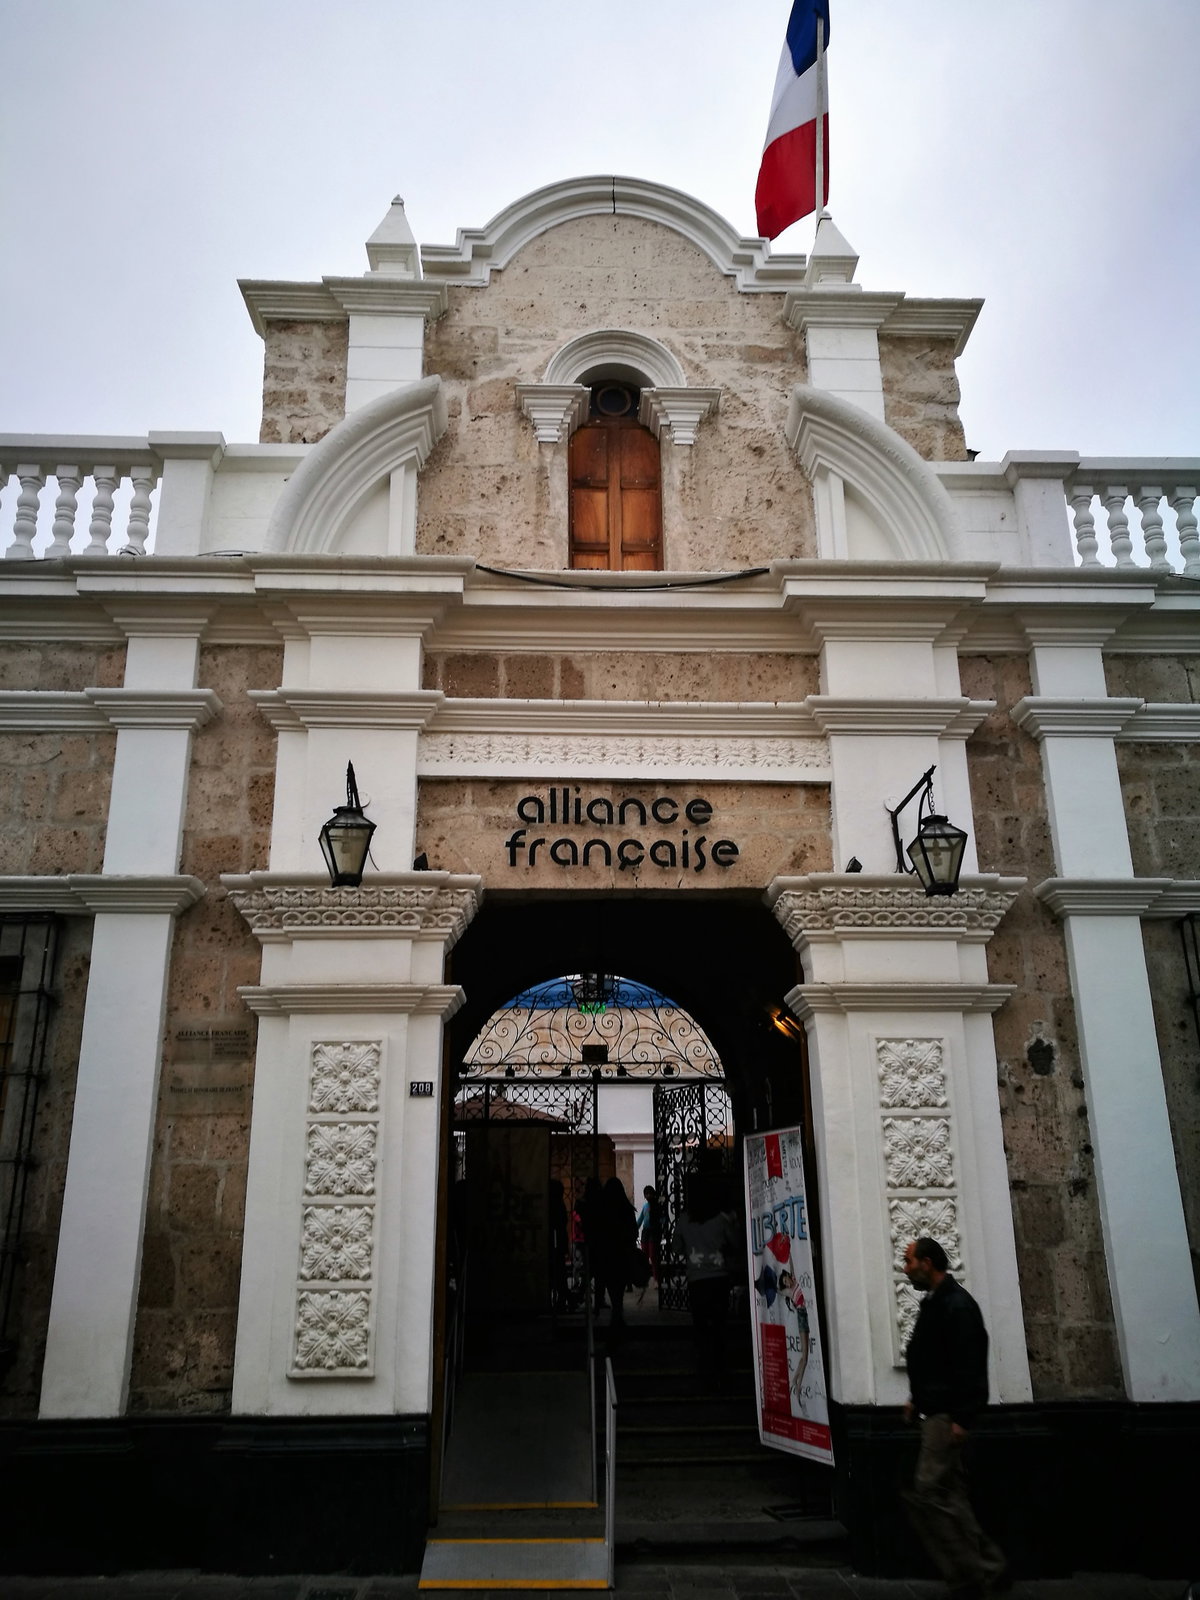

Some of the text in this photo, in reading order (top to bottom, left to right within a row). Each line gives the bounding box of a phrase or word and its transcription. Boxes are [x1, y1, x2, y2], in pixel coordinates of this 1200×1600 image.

[517, 787, 713, 825] alliance
[505, 829, 739, 872] française
[412, 1083, 431, 1092] 208
